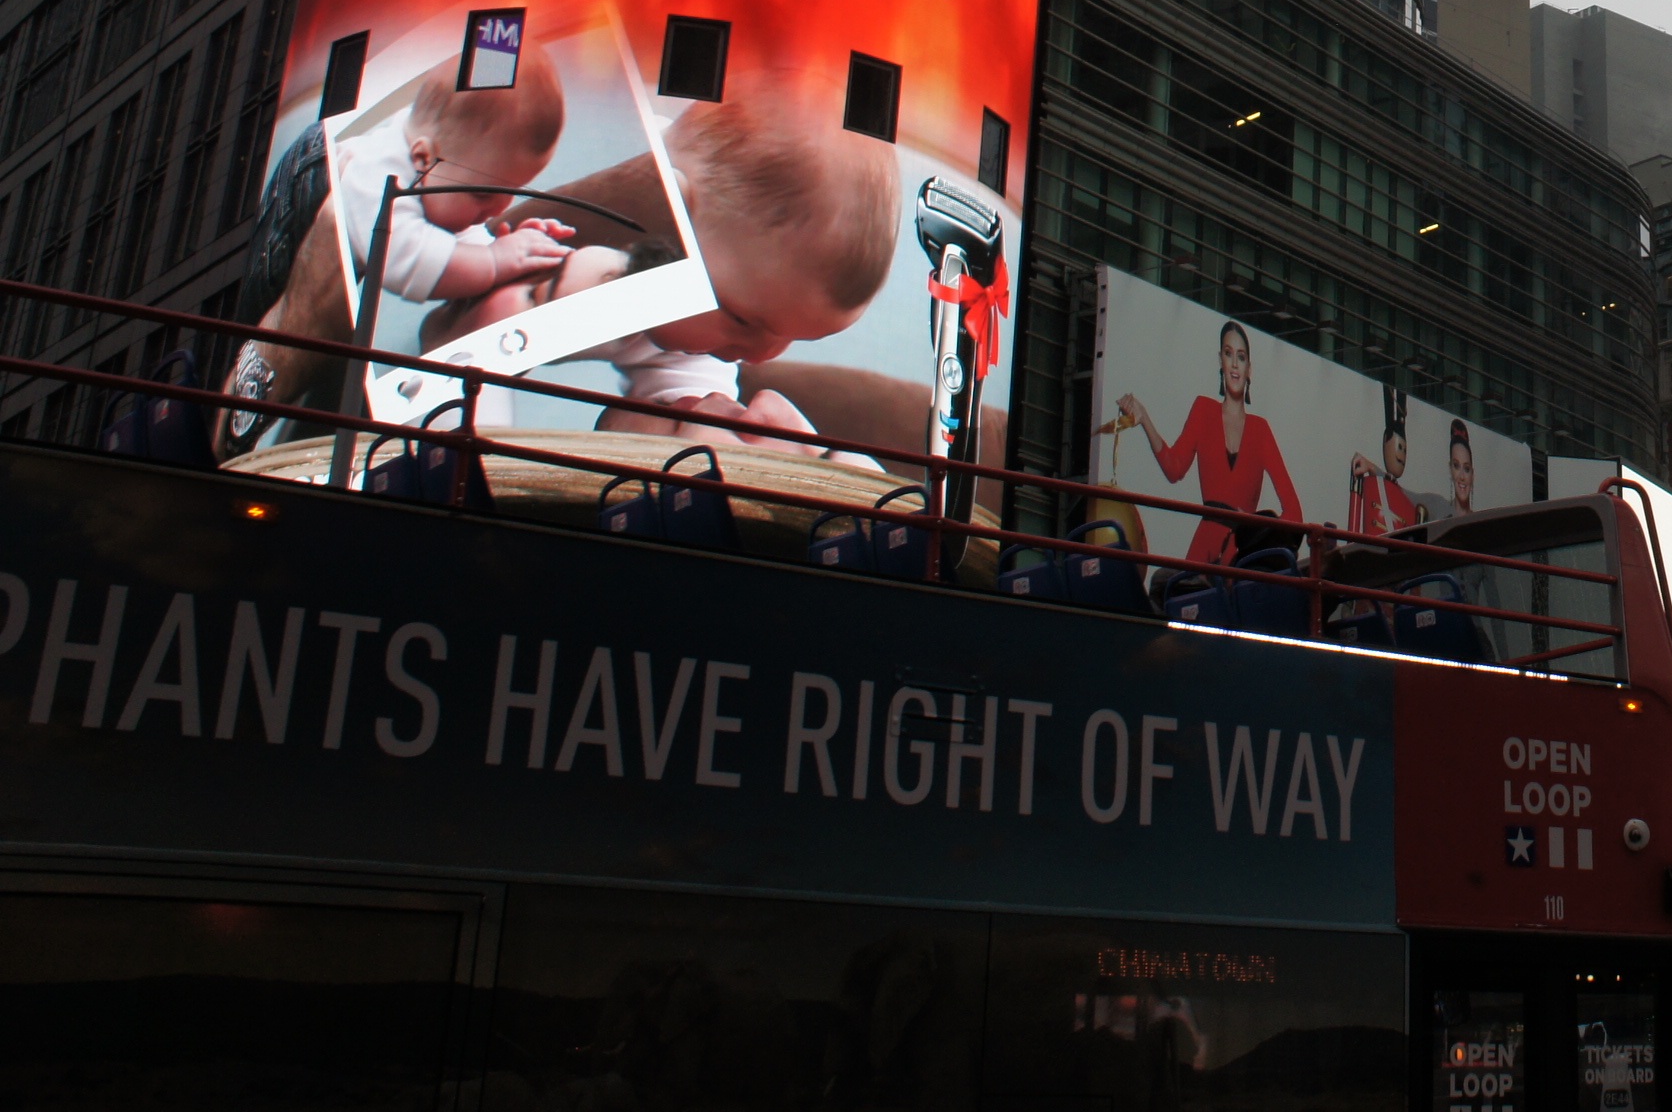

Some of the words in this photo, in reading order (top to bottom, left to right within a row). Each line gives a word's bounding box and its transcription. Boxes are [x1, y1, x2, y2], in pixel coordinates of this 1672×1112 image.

[485, 634, 752, 788] HAVE
[784, 671, 1053, 817] RIGHT
[1081, 708, 1178, 827] OF
[1204, 721, 1365, 842] WAY
[1503, 736, 1592, 776] OPEN
[1504, 780, 1592, 817] LOOP
[1543, 895, 1564, 920] 110
[1449, 1041, 1517, 1068] OPEN
[1584, 1044, 1655, 1064] TICKETS
[1449, 1072, 1514, 1098] LOOP
